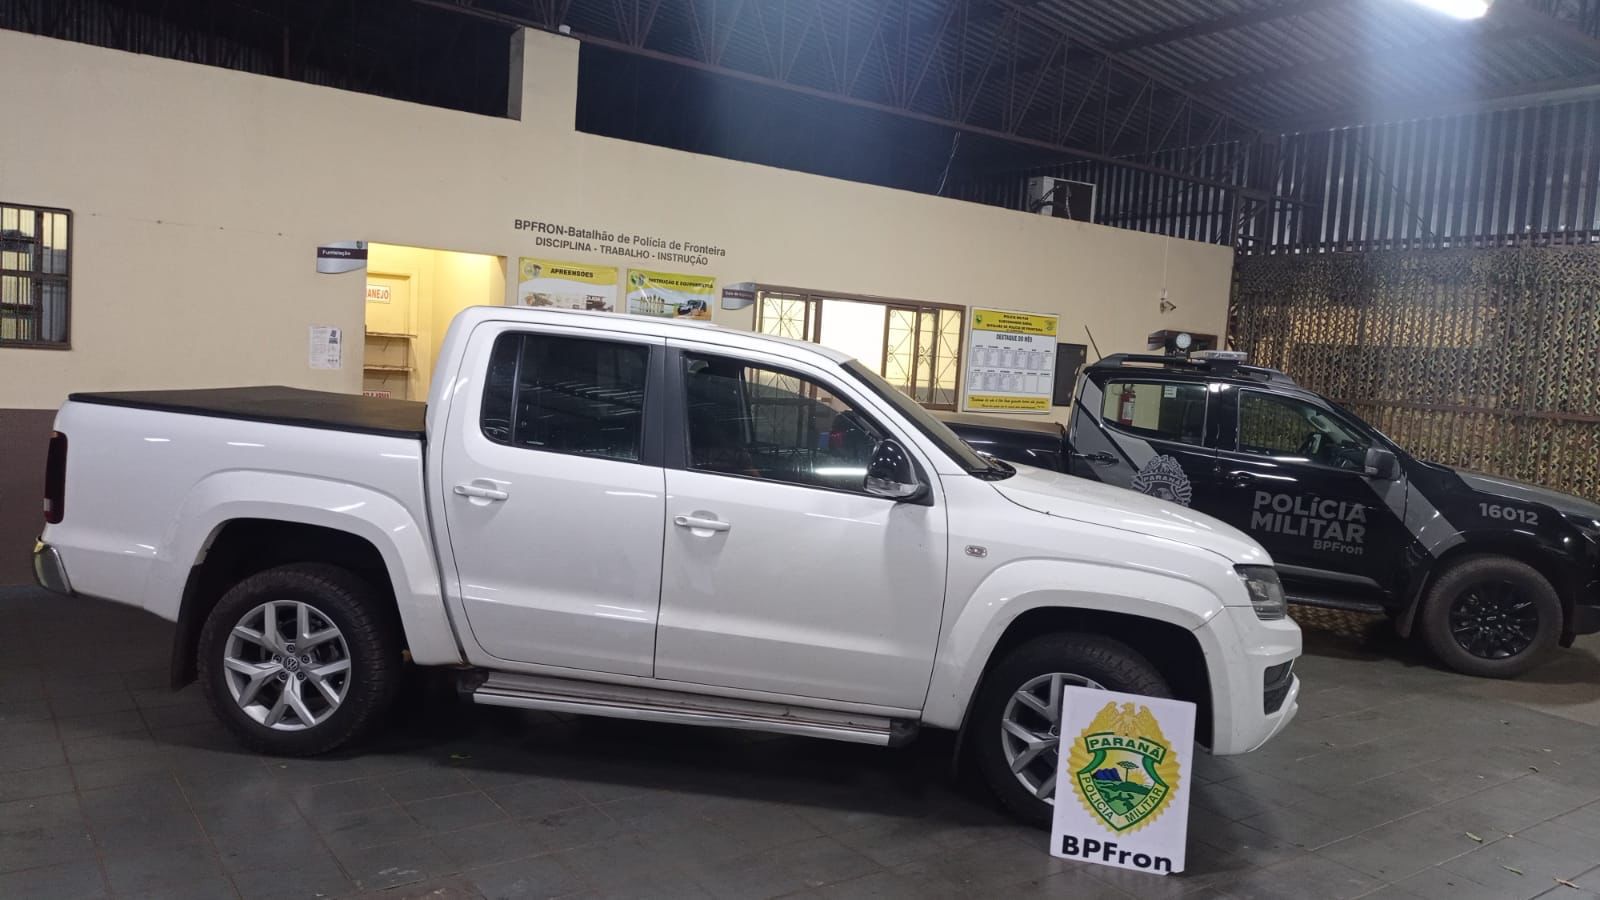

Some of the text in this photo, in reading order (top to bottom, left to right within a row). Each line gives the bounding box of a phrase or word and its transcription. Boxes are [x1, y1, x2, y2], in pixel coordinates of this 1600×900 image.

[514, 219, 615, 242] BPFRON-Batalhão
[617, 233, 630, 244] de
[669, 240, 681, 250] de
[684, 242, 726, 257] Fronteira
[535, 236, 592, 252] DISCIPLINA
[600, 244, 650, 259] TRABALHO
[657, 251, 709, 266] INSTRUÇÃO
[1254, 490, 1367, 523] POLÍCIA
[1479, 502, 1539, 526] 16012
[1250, 510, 1366, 544] MILITAR
[1312, 539, 1364, 555] BPFron
[1089, 737, 1161, 758] PARANÁ
[1125, 787, 1163, 823] MILITAR
[1062, 834, 1172, 872] BPFron
